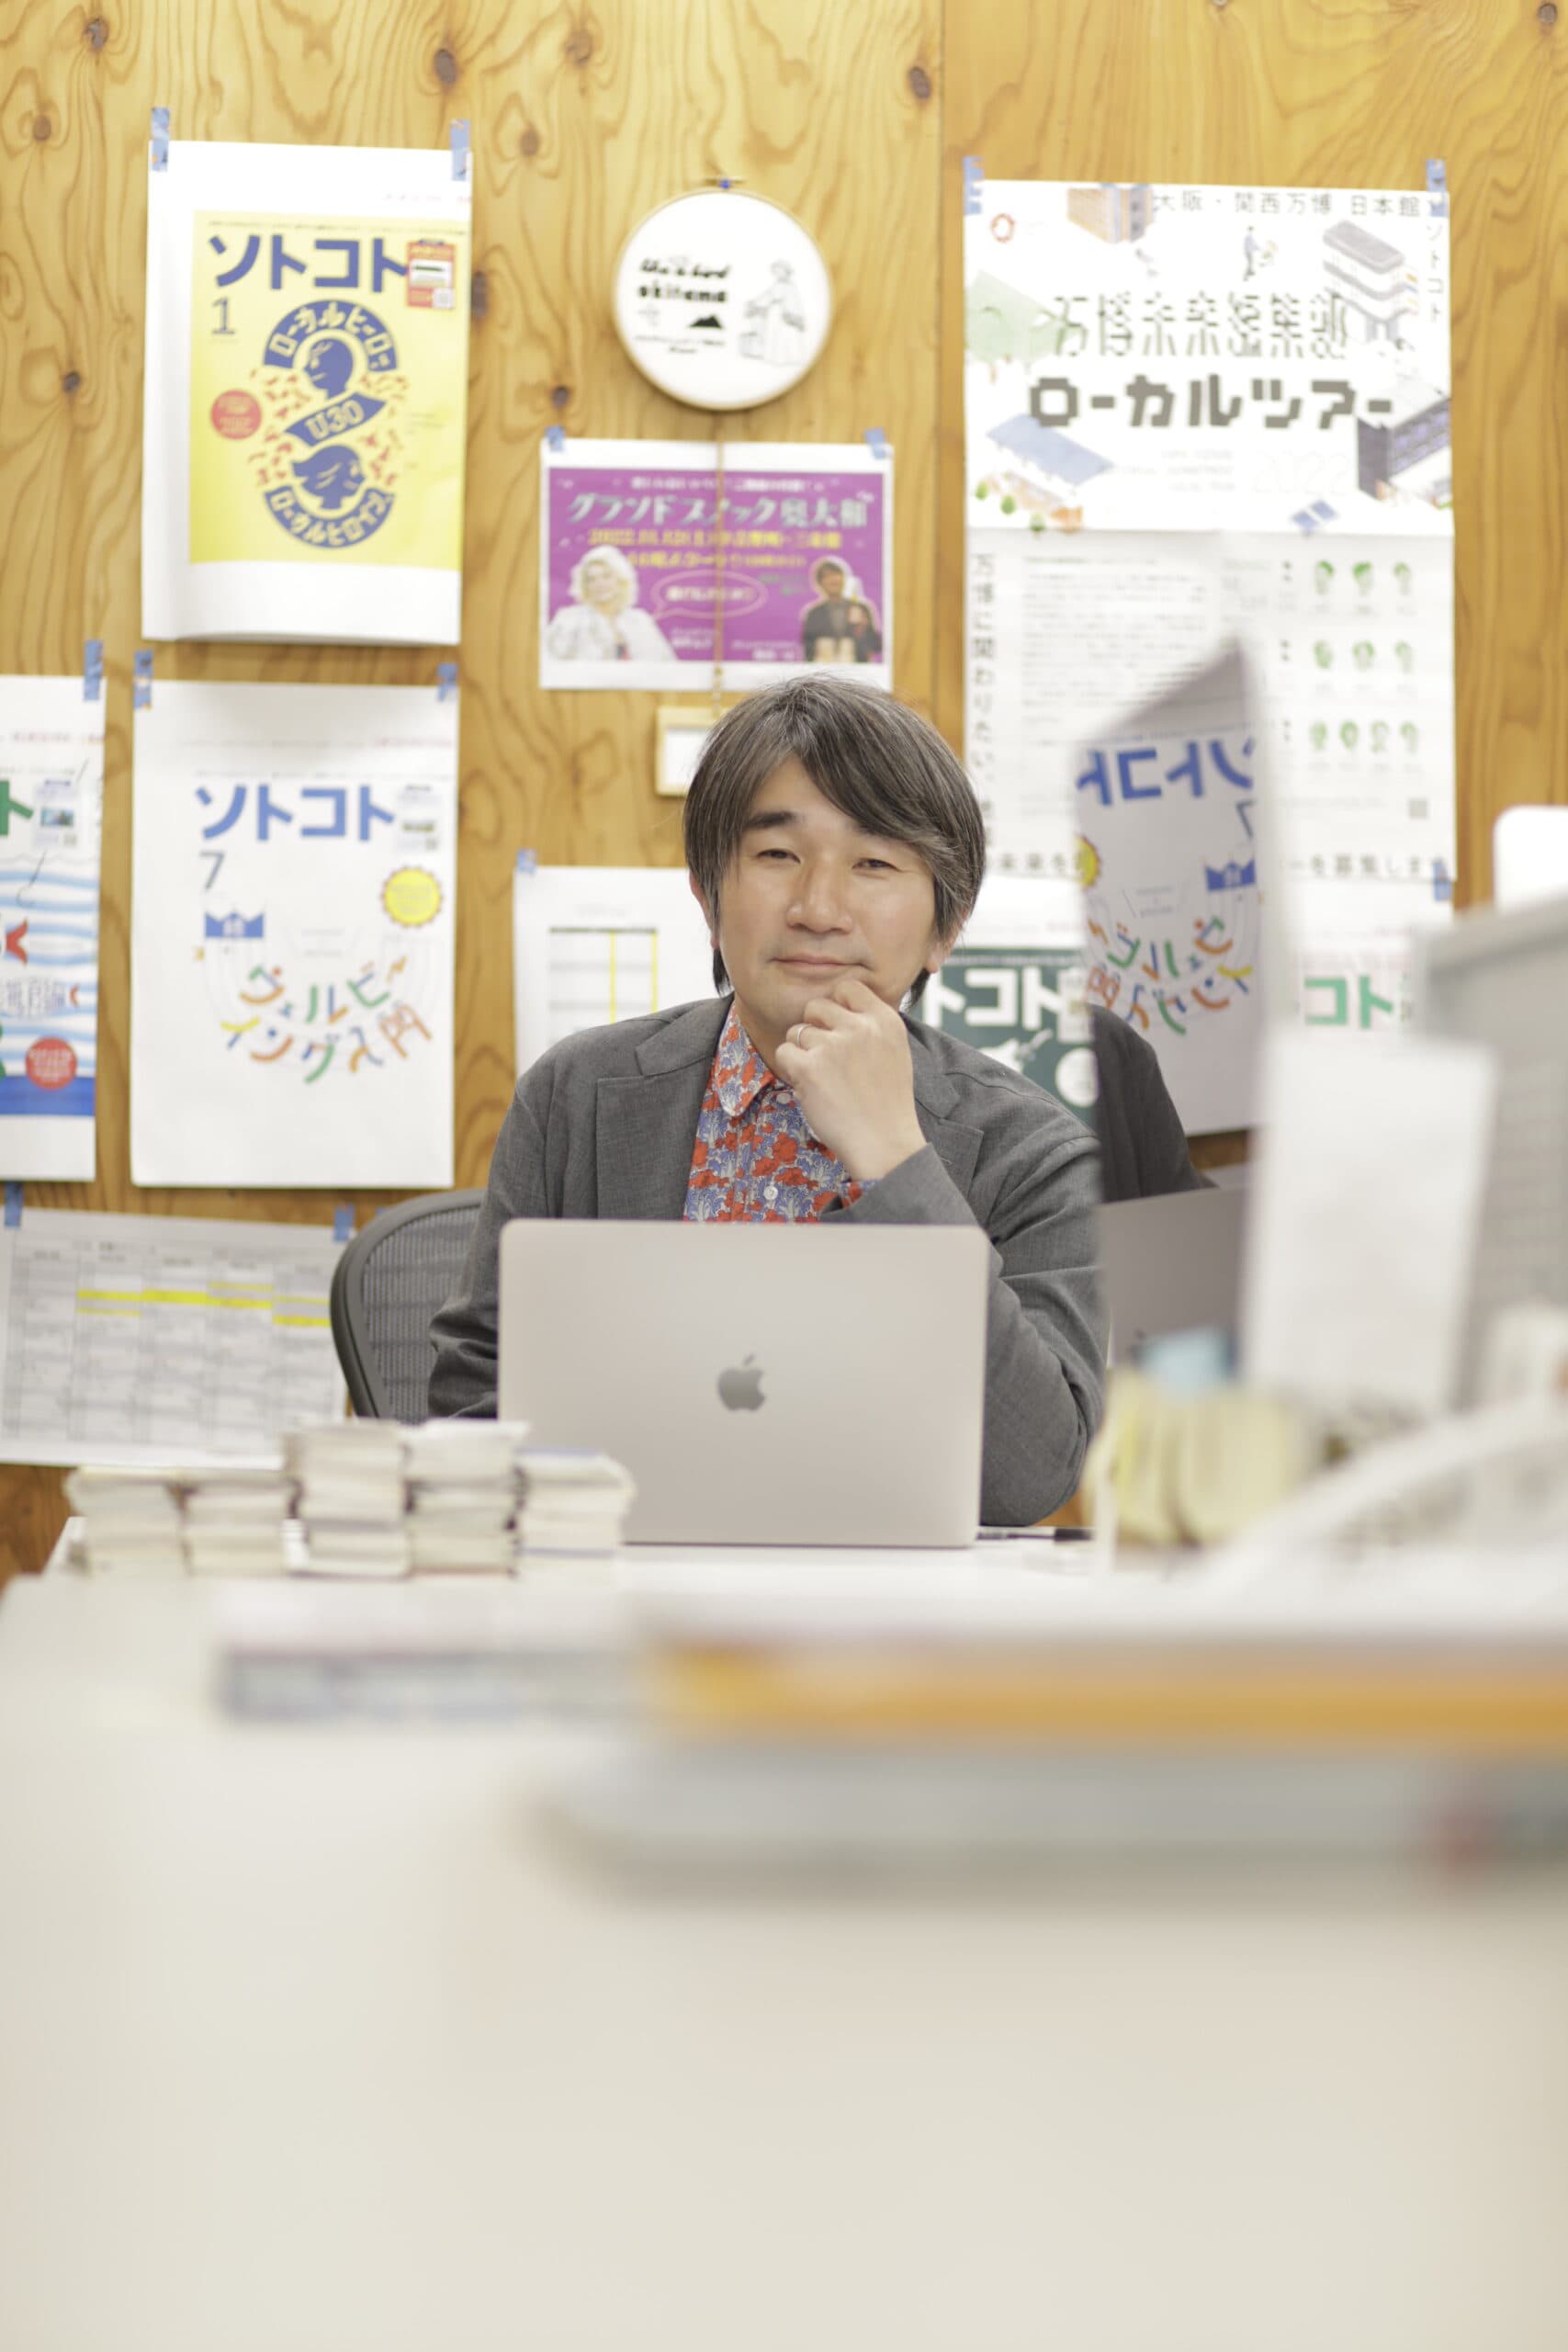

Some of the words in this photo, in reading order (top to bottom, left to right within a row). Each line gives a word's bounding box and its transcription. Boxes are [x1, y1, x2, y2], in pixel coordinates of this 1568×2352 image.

[1350, 195, 1420, 217] 日本館
[209, 234, 407, 293] ソトコト
[1426, 223, 1444, 323] ソトコト
[211, 296, 235, 335] 1
[306, 401, 364, 441] U30
[1030, 375, 1393, 430] ローカルツアー
[195, 785, 395, 842] ソトコト
[199, 852, 225, 891] 7
